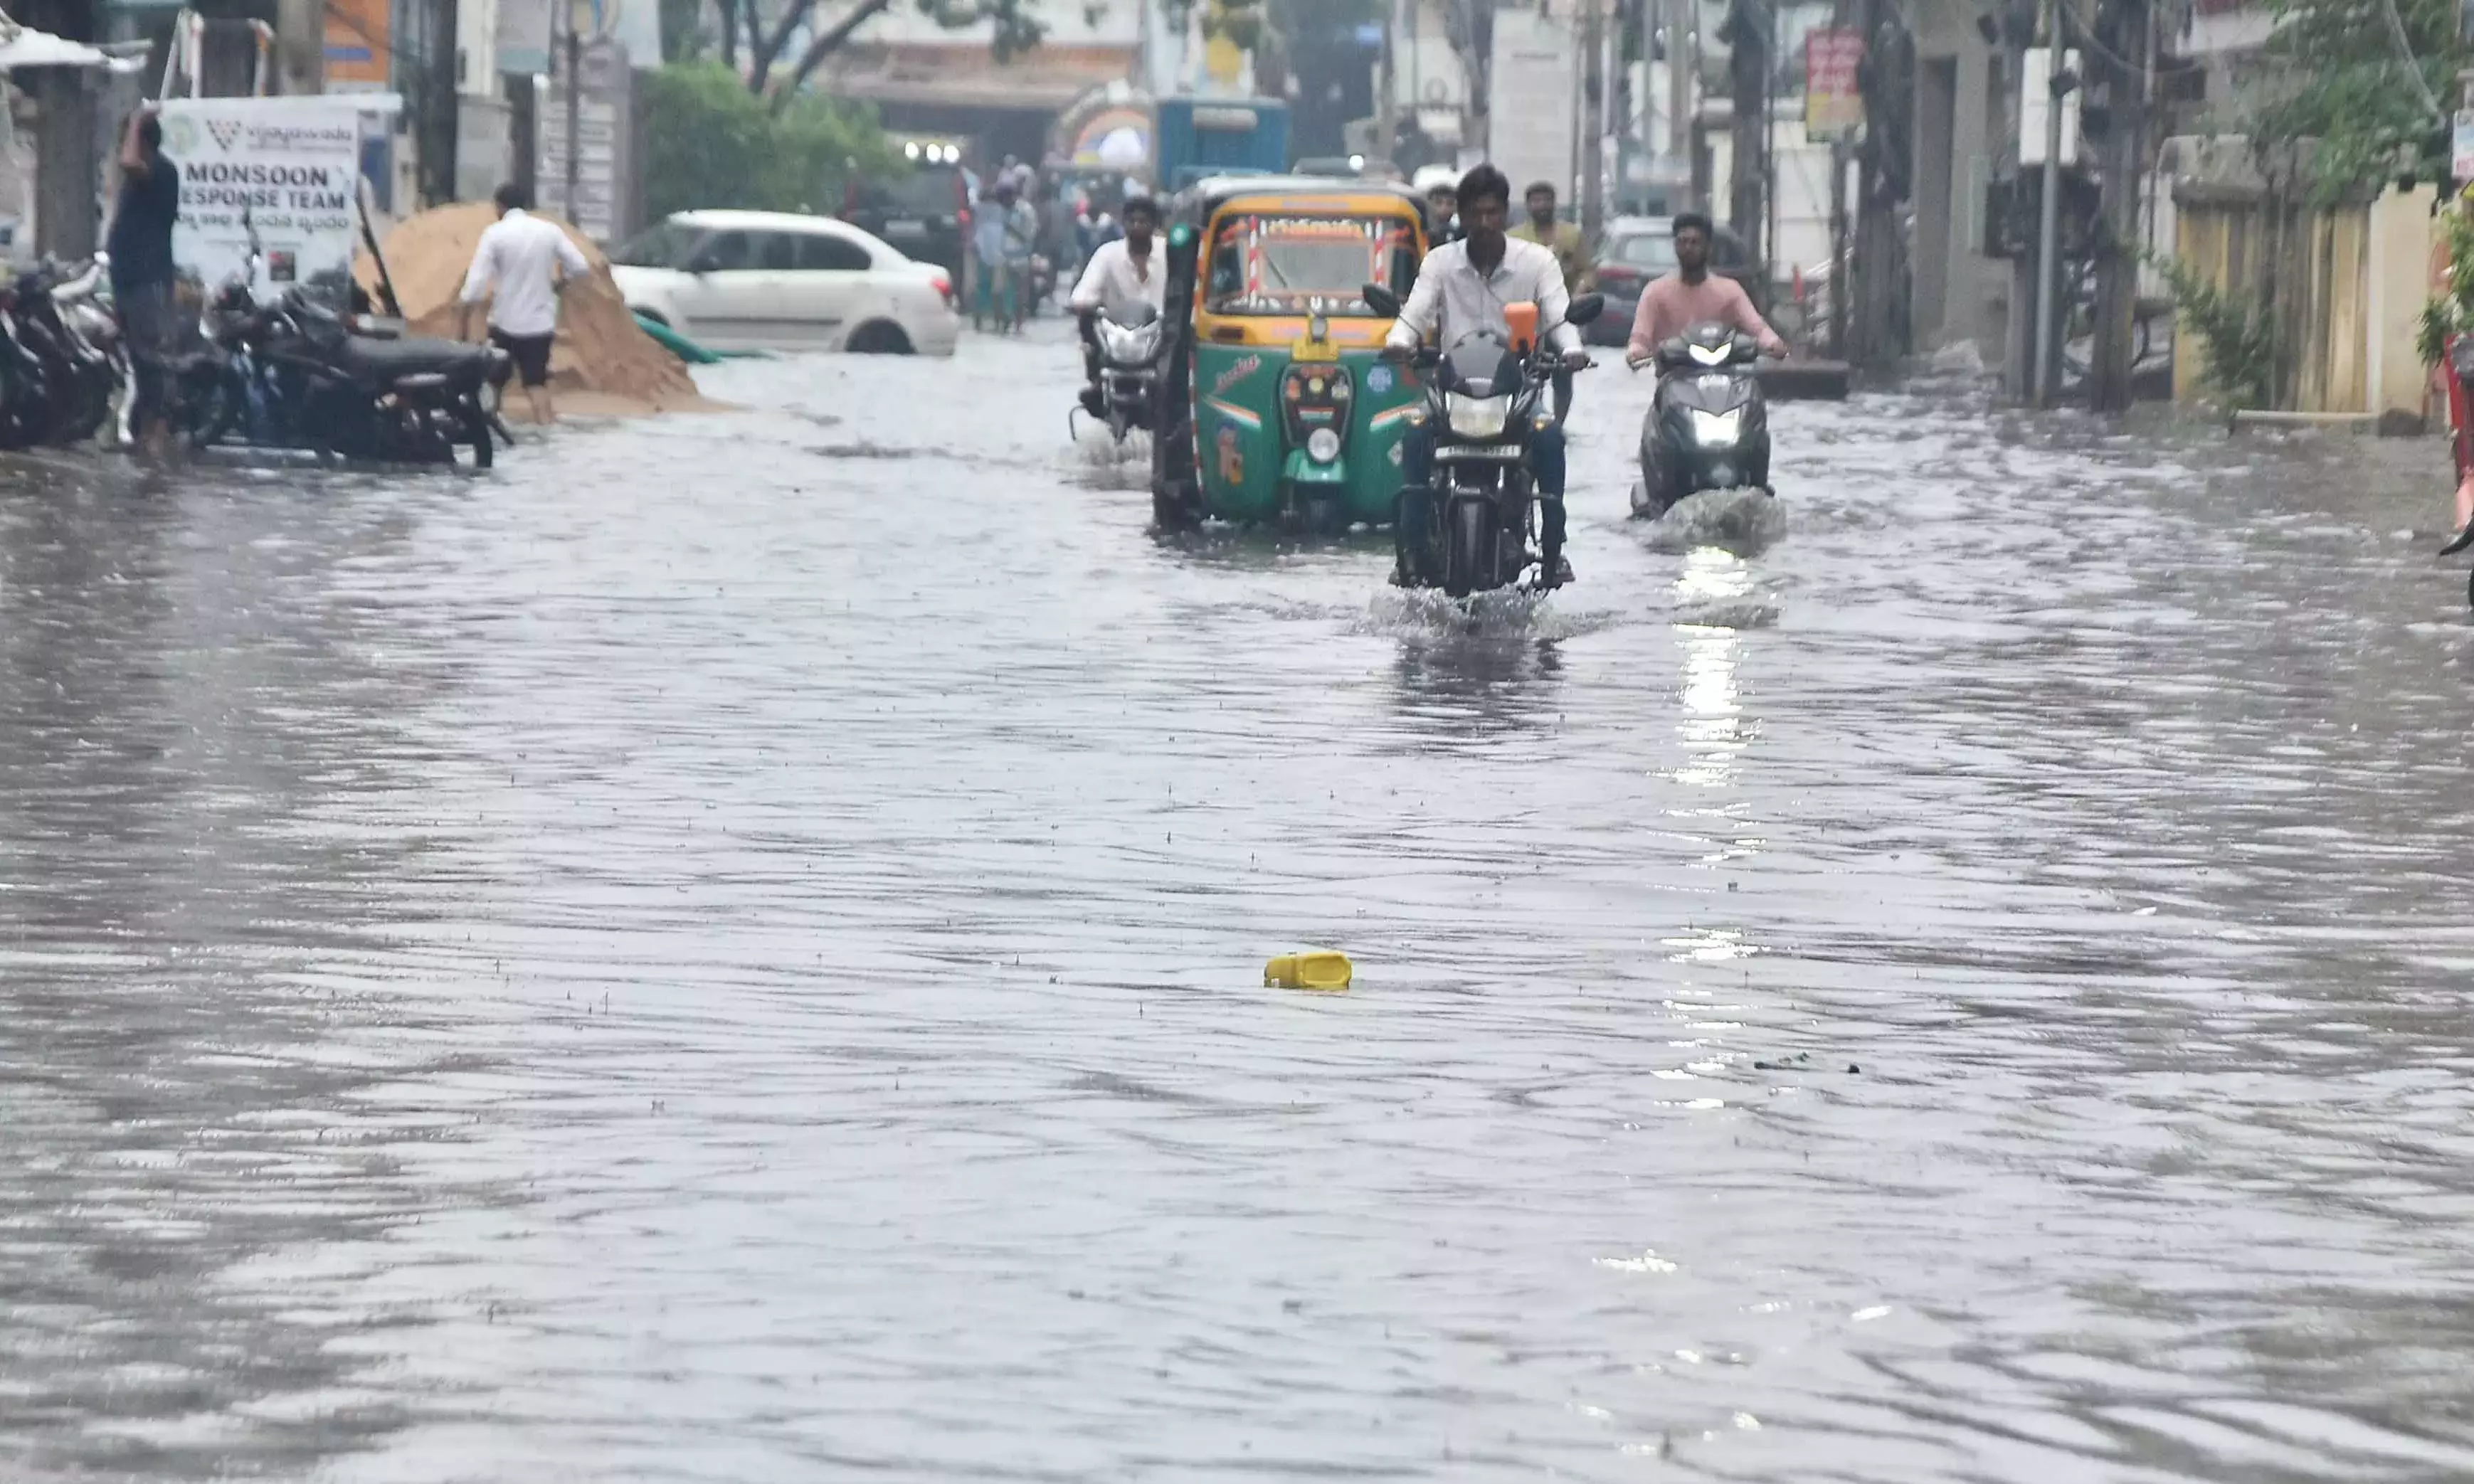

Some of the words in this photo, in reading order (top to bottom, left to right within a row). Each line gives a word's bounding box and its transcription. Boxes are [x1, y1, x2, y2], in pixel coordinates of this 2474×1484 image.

[186, 163, 328, 186] MONSOON
[180, 186, 280, 207] ESPONSE
[288, 189, 346, 209] TEAM
